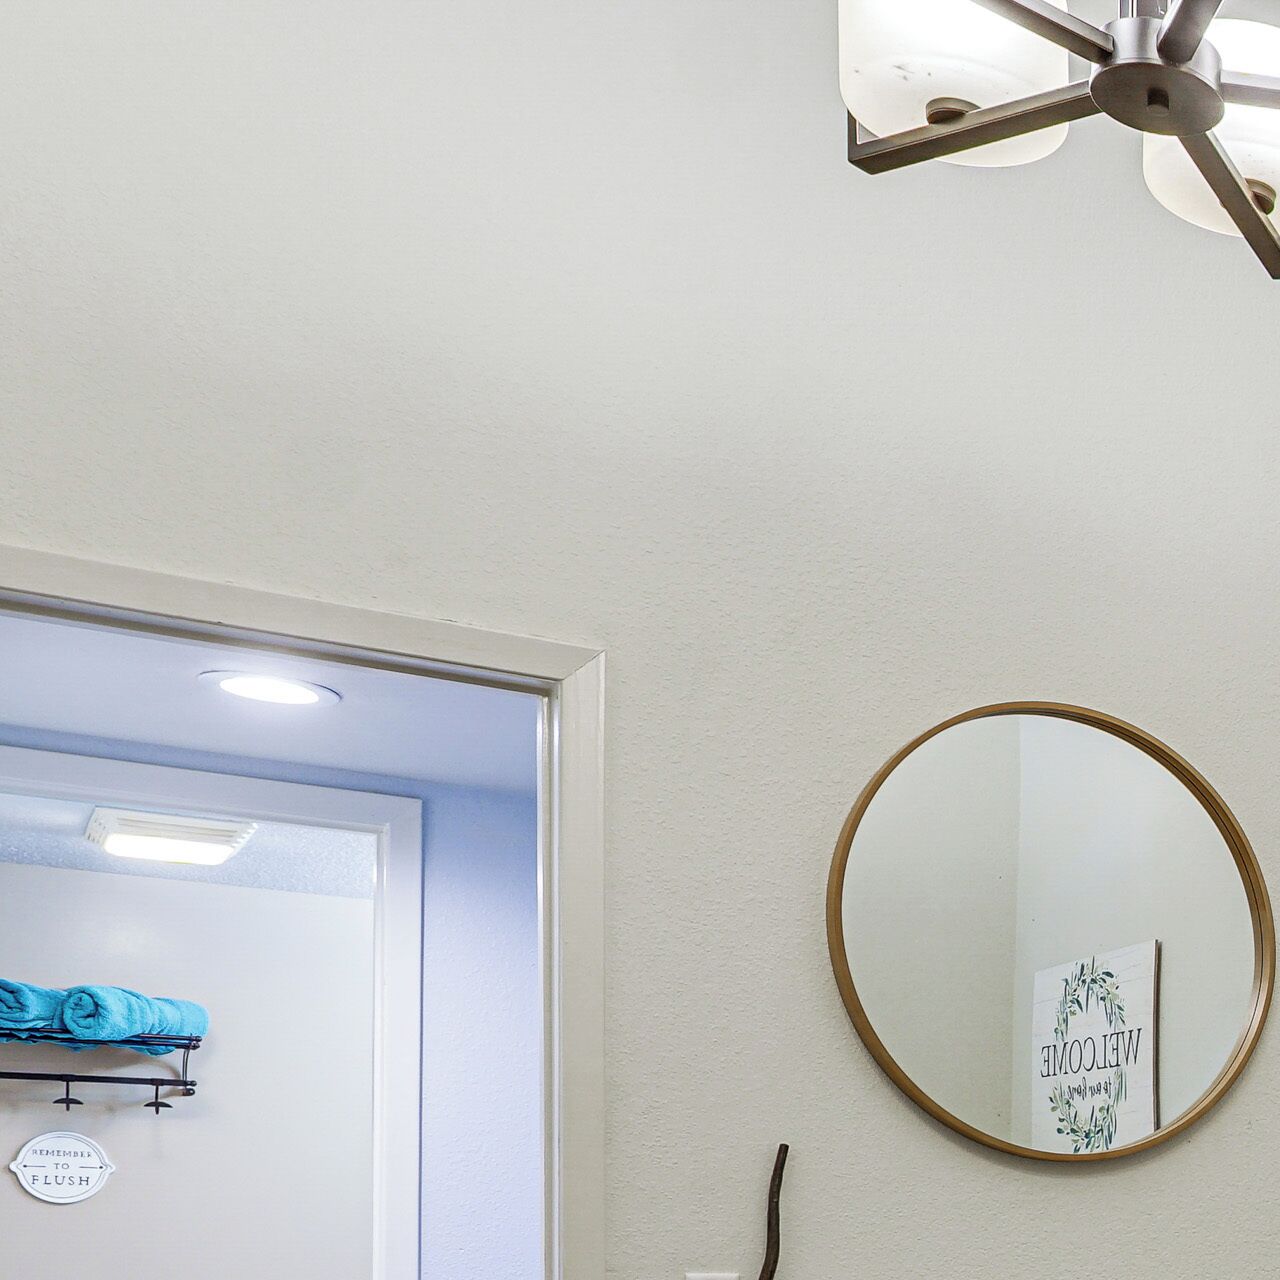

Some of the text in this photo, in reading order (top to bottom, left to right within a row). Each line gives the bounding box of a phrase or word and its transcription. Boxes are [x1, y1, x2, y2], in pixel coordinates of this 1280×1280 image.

[32, 1149, 92, 1158] REMEMBER
[53, 1162, 70, 1170] TO
[31, 1175, 90, 1186] FLUSH
